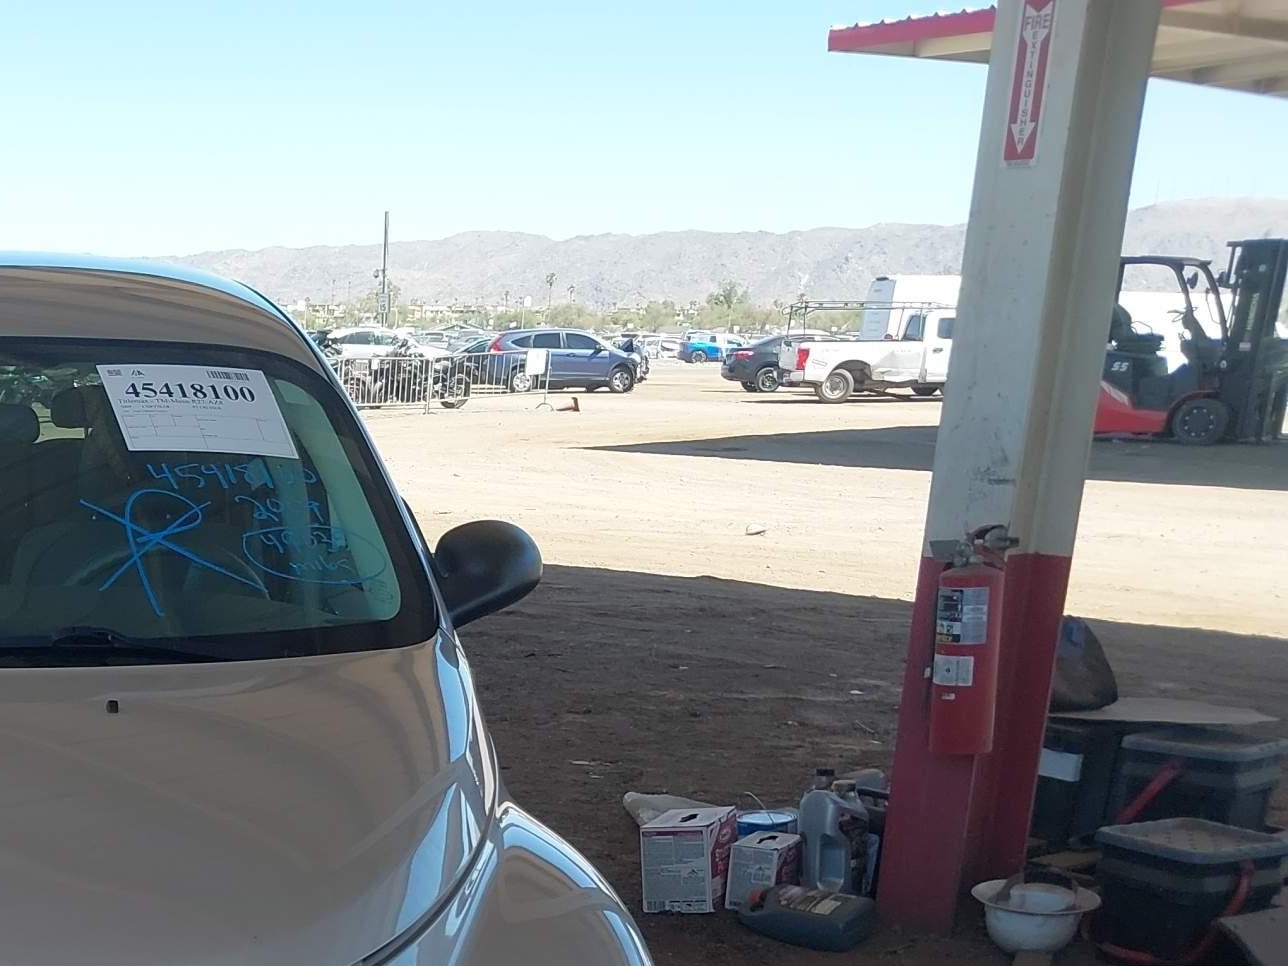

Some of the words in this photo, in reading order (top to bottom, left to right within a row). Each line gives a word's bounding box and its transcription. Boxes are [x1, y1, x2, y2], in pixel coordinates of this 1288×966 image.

[1023, 13, 1052, 31] FIRE
[1016, 30, 1037, 146] EXTINGUISHER
[125, 382, 255, 403] 45418100
